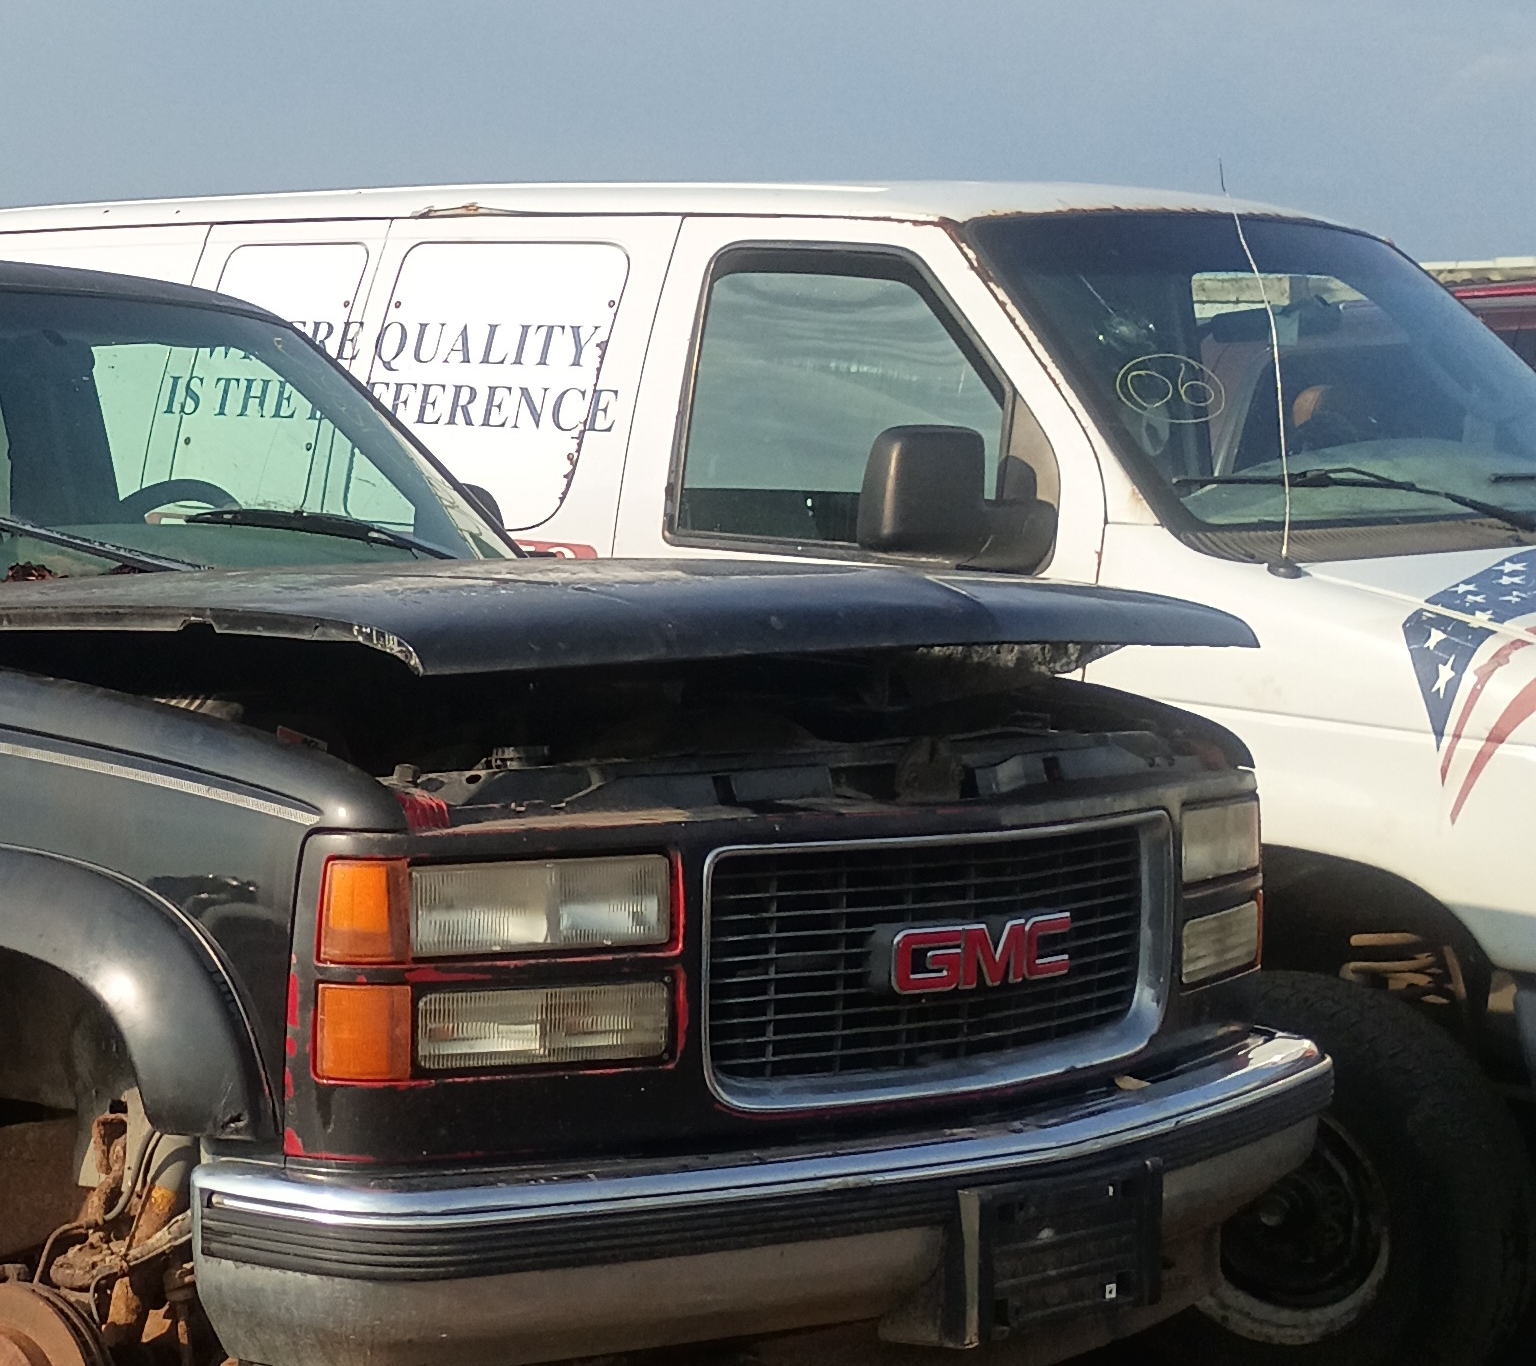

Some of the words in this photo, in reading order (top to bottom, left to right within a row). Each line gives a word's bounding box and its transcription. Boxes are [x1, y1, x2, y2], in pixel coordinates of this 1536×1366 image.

[376, 321, 602, 372] QUALITY
[163, 375, 205, 416] IS
[214, 377, 297, 419] THE
[891, 911, 1072, 995] GMC
